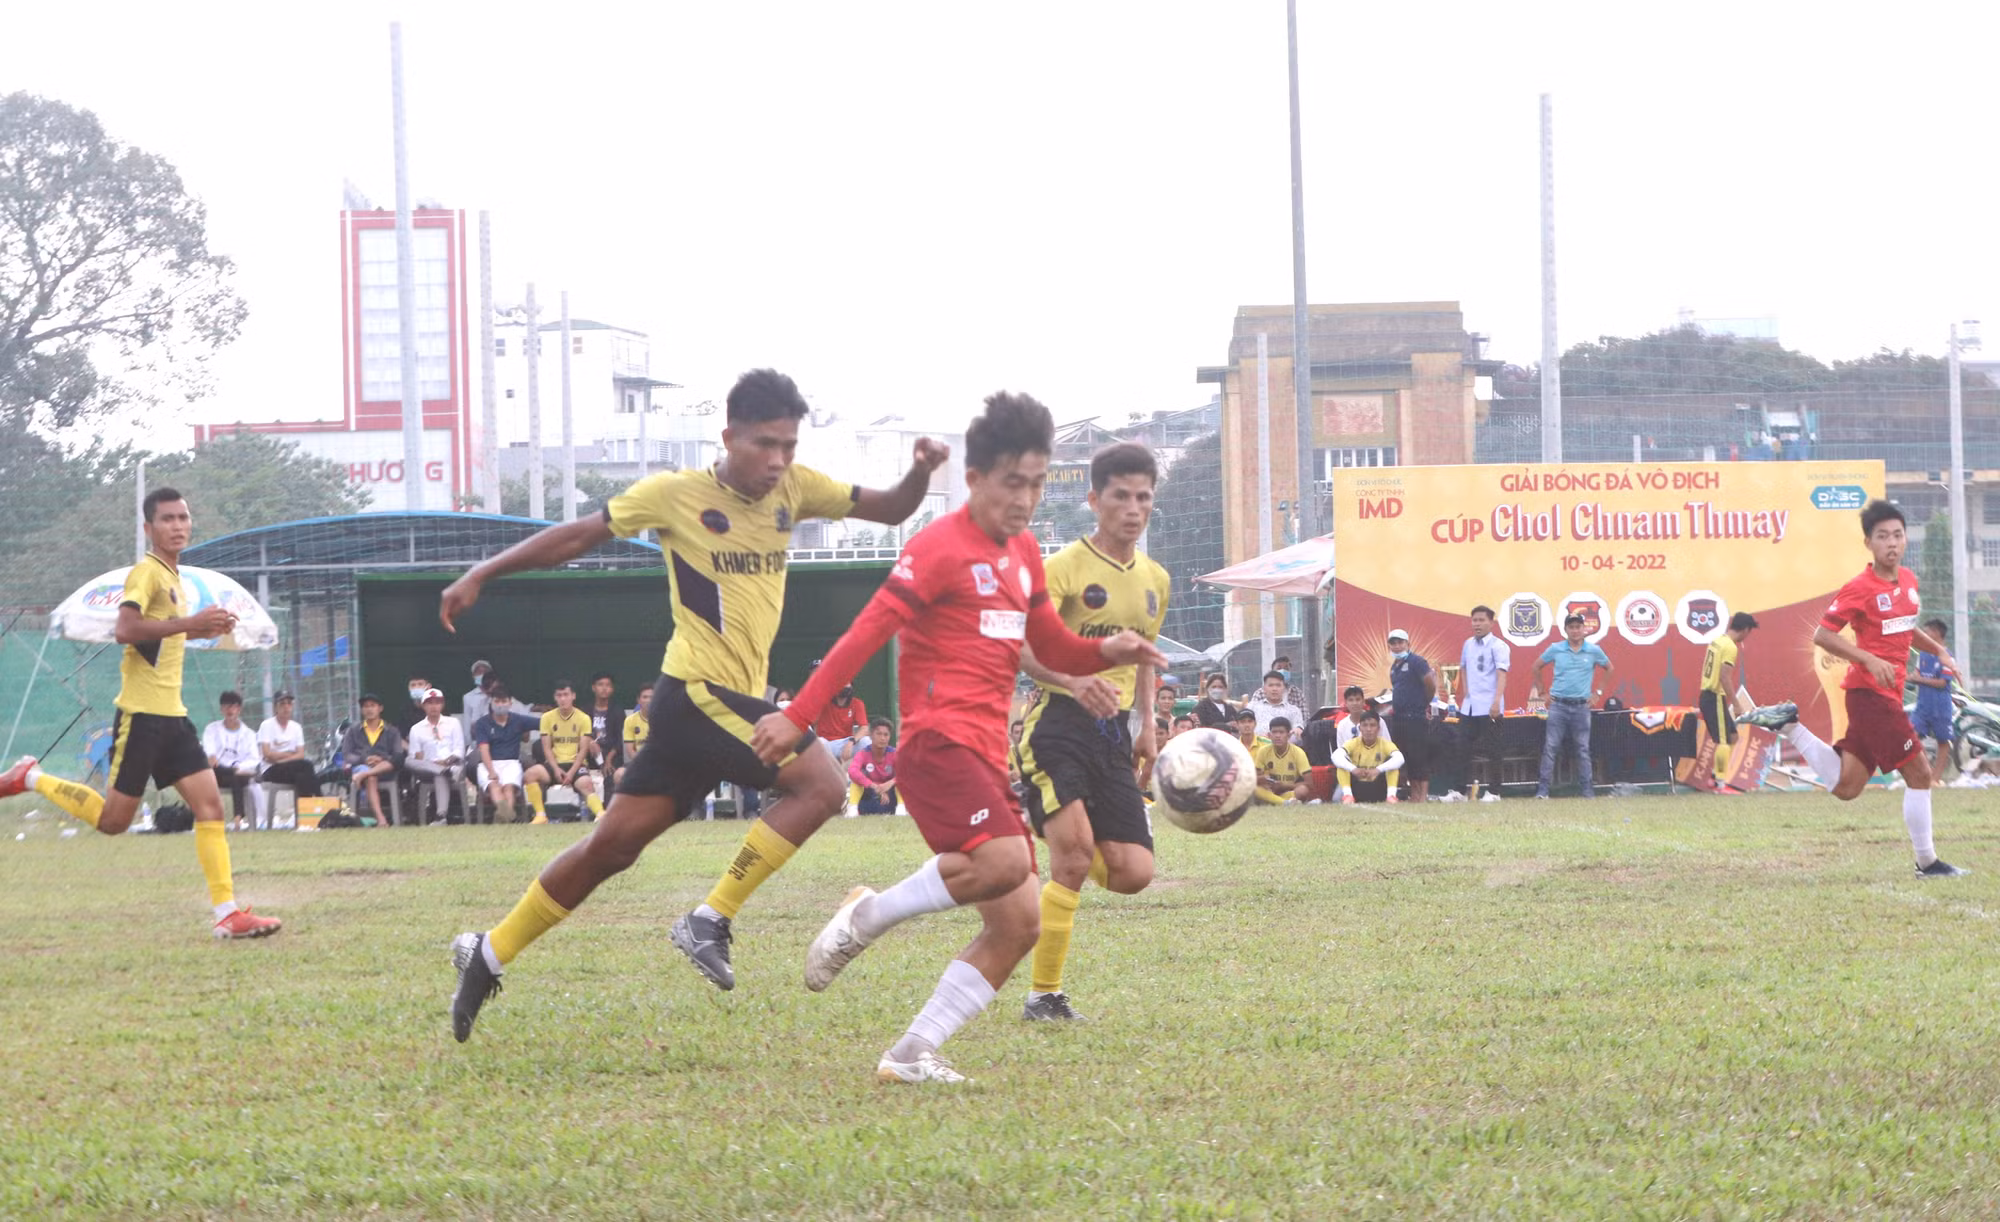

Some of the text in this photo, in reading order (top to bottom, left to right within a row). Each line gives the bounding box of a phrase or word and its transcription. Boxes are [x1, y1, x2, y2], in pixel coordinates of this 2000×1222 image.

[1501, 467, 1720, 493] GIẢI BÓNG ĐÁ VÔ ĐỊCH
[1359, 497, 1403, 519] IMD
[1430, 500, 1789, 544] CÚP Chol Chnam Thmay
[710, 550, 761, 575] KHMER
